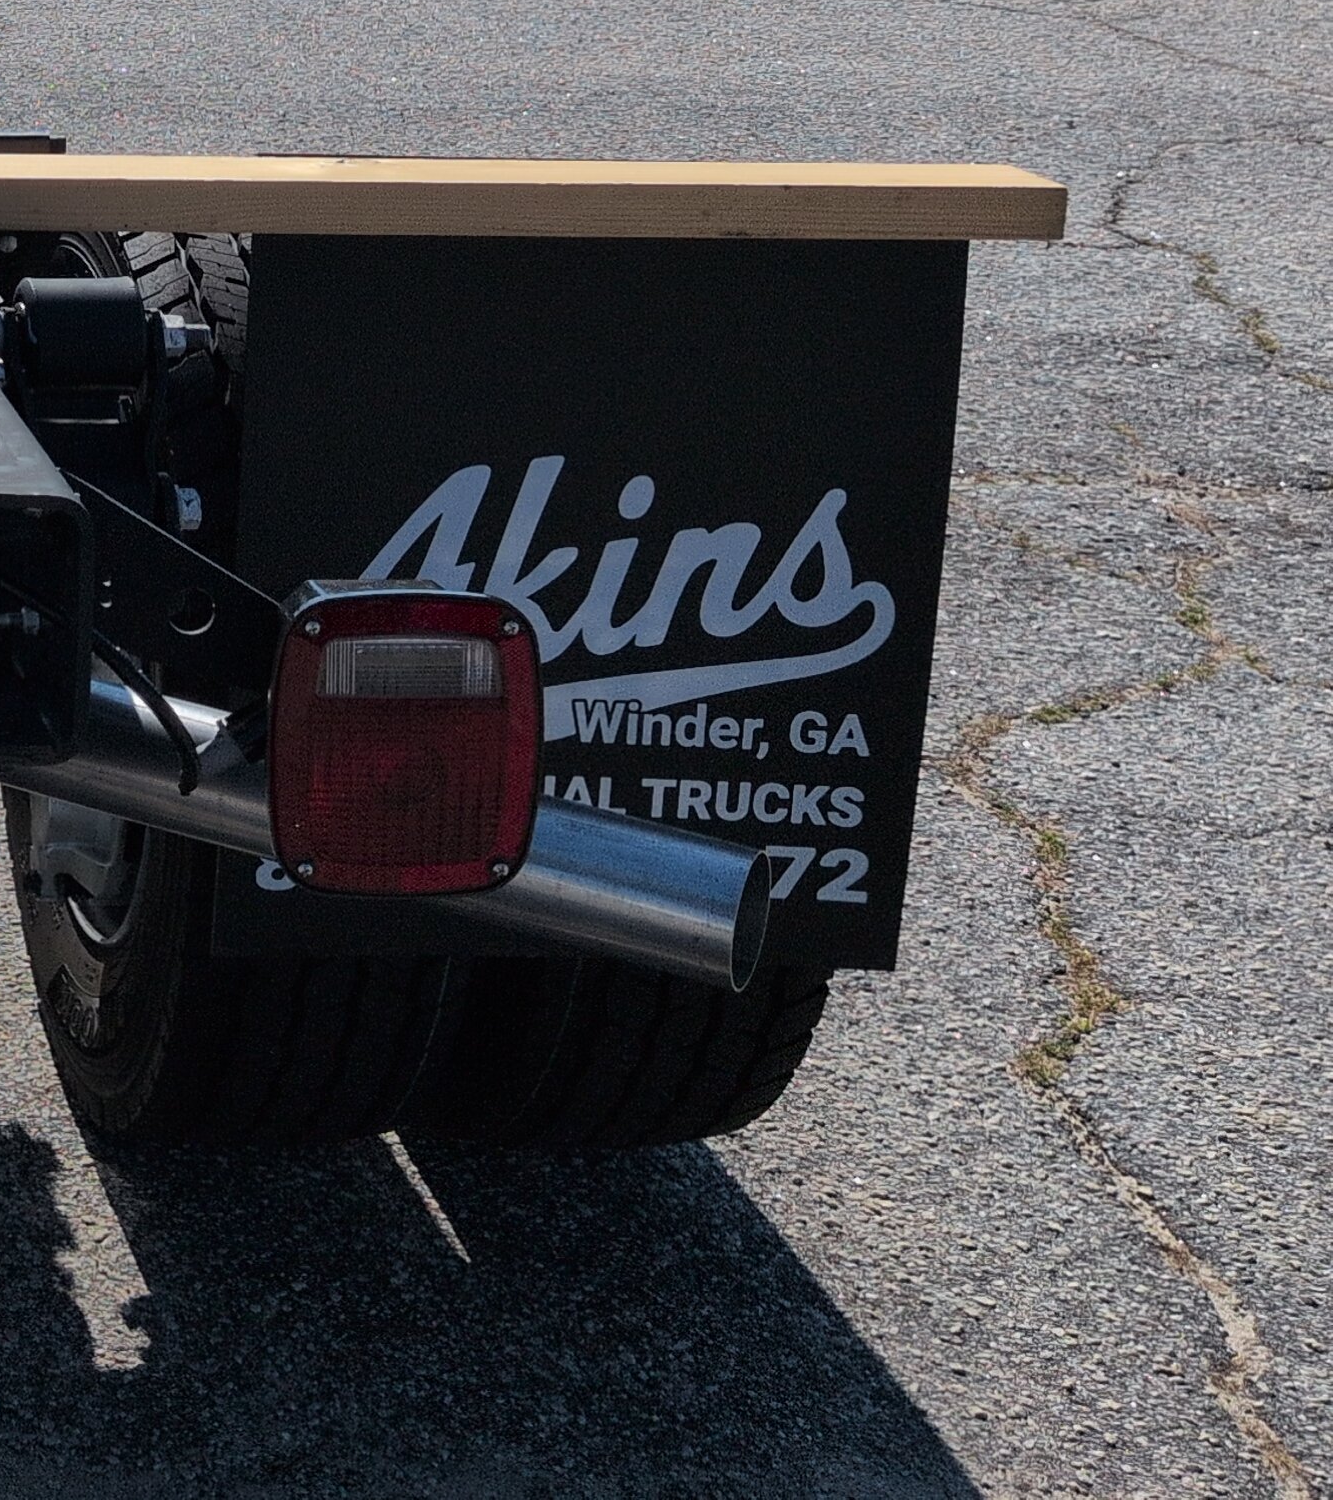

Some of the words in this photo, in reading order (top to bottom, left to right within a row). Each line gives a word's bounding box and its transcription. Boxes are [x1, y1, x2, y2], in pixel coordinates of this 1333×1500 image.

[573, 699, 769, 760] Winder,
[790, 710, 870, 757] GA
[641, 778, 865, 828] TRUCKS
